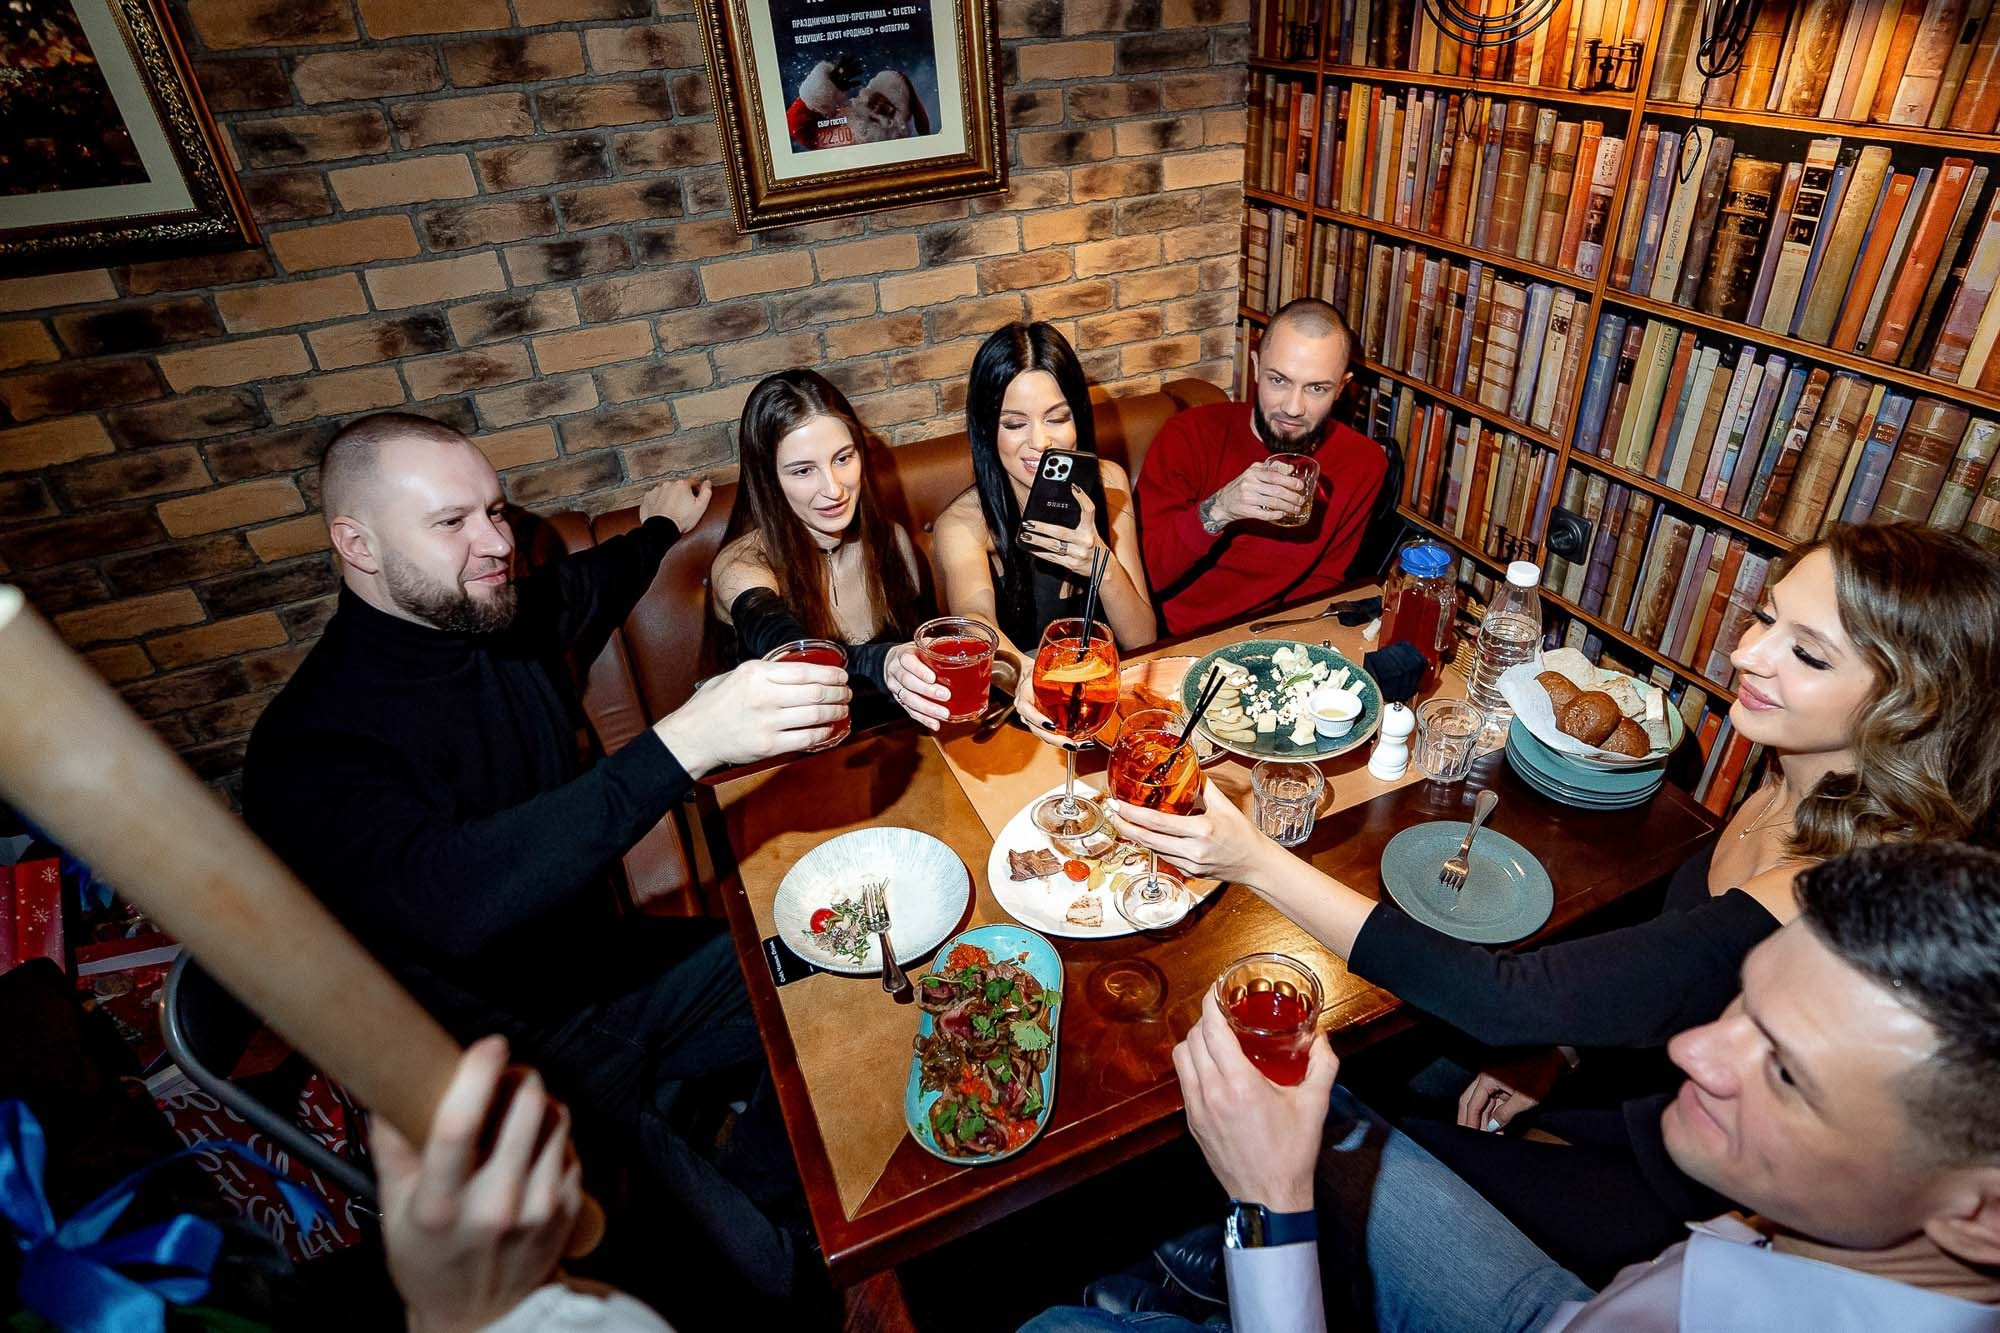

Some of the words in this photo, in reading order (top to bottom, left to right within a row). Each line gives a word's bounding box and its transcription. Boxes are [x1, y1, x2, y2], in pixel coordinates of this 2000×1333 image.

[792, 15, 836, 29] ПРАЗДНИЧНАЯ
[836, 9, 887, 23] ШОУ-ПРОГРАММА
[901, 5, 916, 15] СЕТЫ
[794, 33, 826, 44] ВЕДУЩИЕ:
[827, 30, 842, 40] ДУЭТ
[843, 27, 874, 38] «РОДНЫЕ»
[880, 22, 910, 33] ФОТОГРАФ
[819, 128, 852, 145] 22:00
